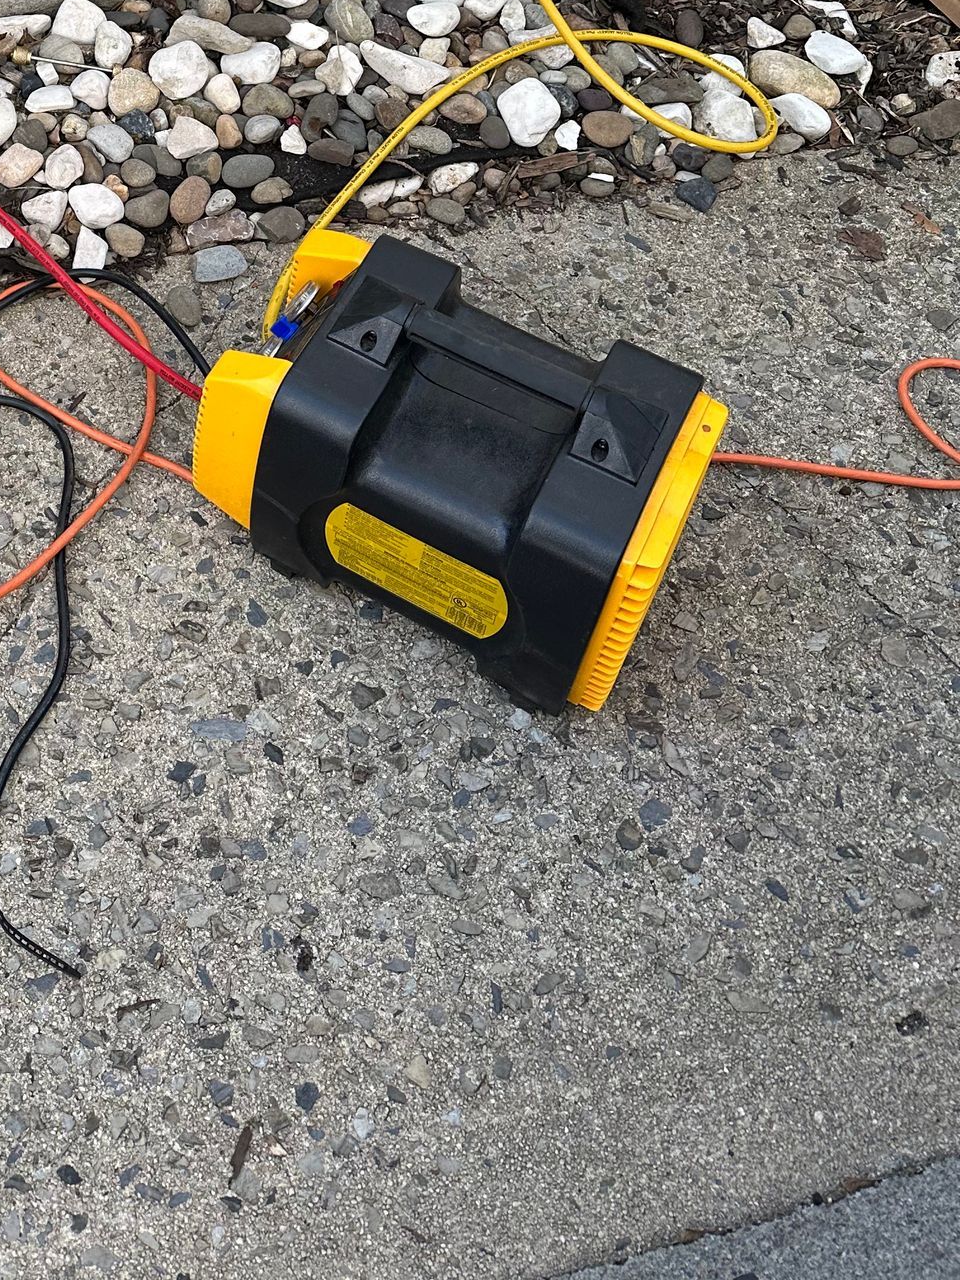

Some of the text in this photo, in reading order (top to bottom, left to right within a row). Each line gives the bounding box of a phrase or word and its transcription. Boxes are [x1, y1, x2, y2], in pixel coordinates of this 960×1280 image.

[391, 126, 403, 139] YELLOW
[379, 139, 392, 152] JACKET
[352, 168, 365, 183] Charging
